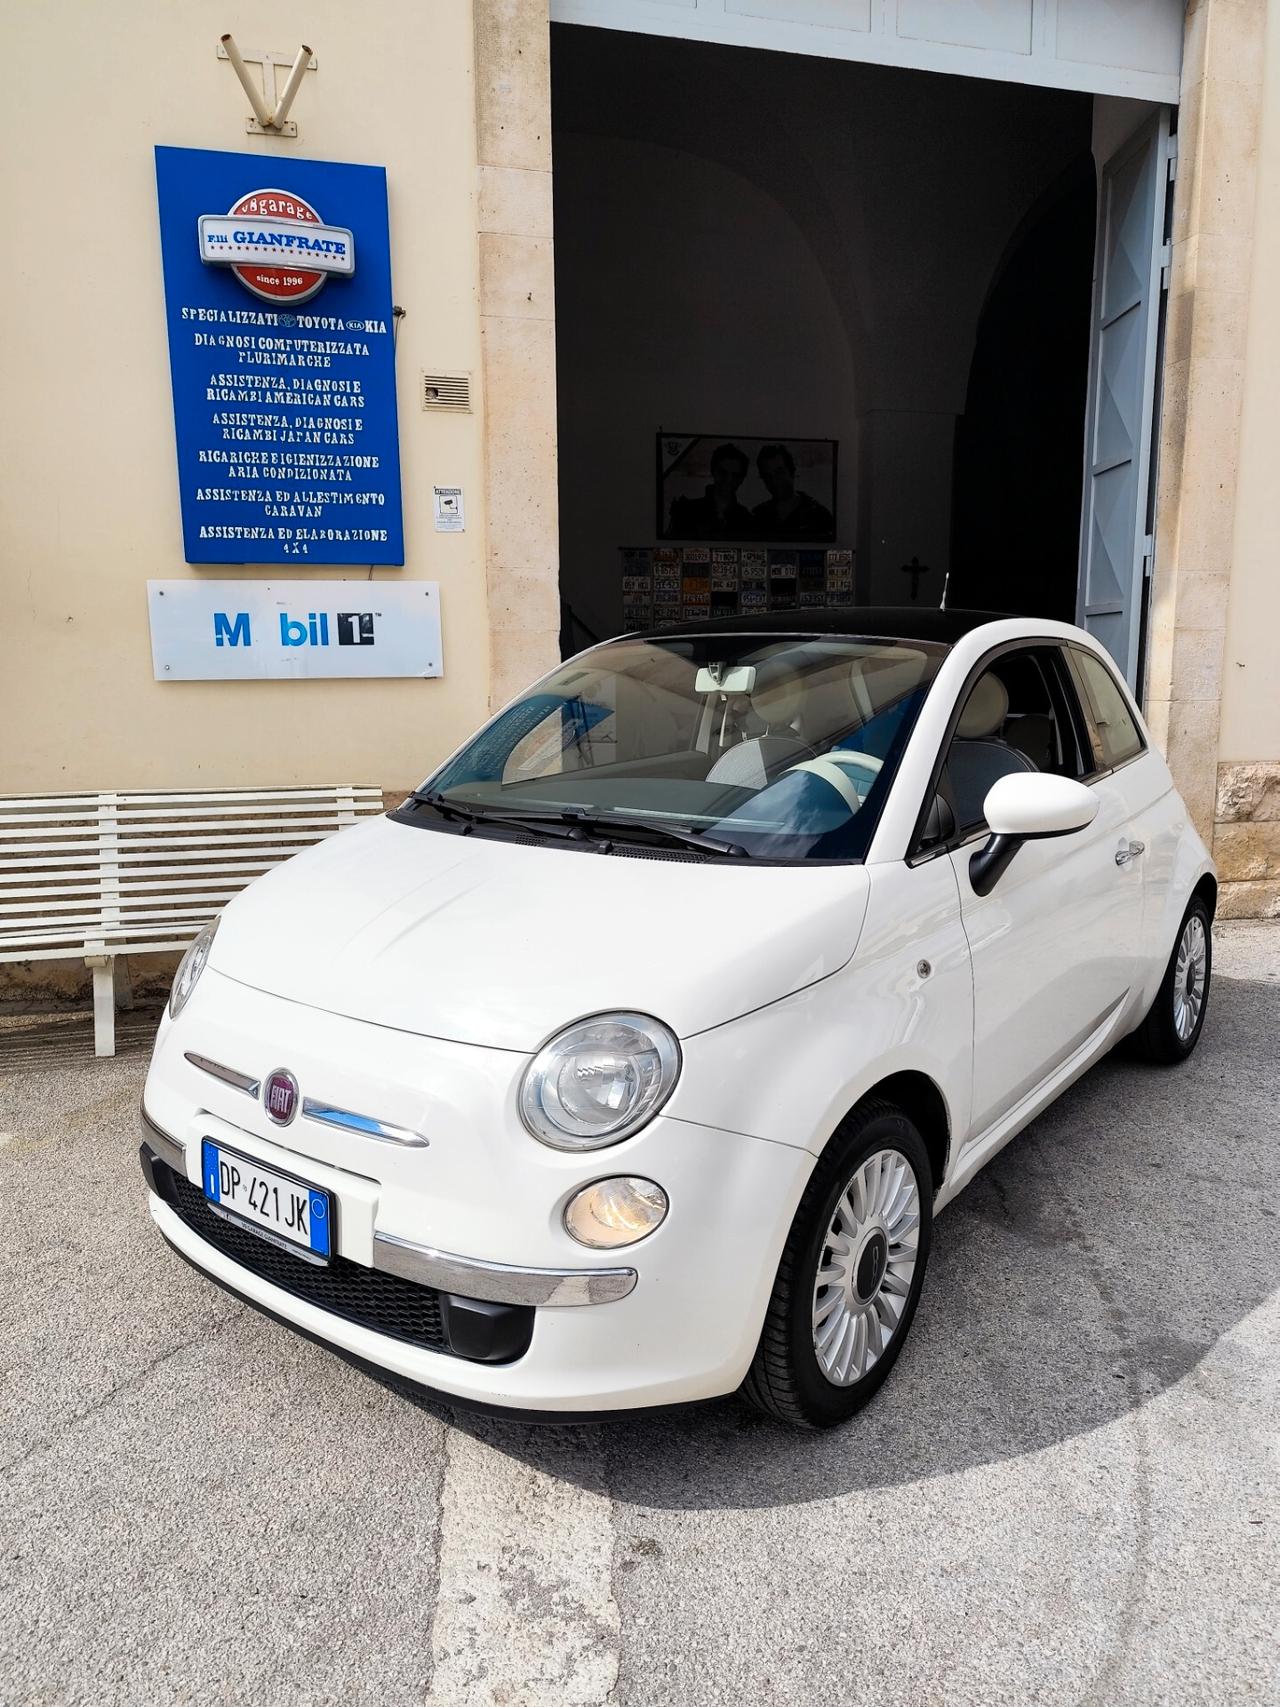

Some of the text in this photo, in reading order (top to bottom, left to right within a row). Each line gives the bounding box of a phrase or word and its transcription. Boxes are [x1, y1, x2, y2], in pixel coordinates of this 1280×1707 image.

[233, 231, 346, 255] GIANFRATE
[256, 275, 303, 286] since 1996
[181, 307, 278, 326] SPECIALIZZATI
[297, 315, 345, 331] TOYOTA
[364, 320, 387, 333] KIA
[194, 333, 370, 356] DIAGNOSI COMPUTERIZZATA
[238, 351, 331, 368] PLURIMARCHE
[293, 378, 351, 393] DIAGNOSI
[353, 381, 361, 393] E
[206, 388, 365, 408] RICAMBI AMERICAN CARS
[295, 416, 353, 431] DIAGNOSI
[355, 419, 363, 431] E
[222, 428, 355, 445] RICAMBI JAPAN CARS
[199, 450, 379, 468] RICARICHE E IGIENIZZAZIONE
[228, 466, 352, 481] ARIA CONDIZIONATA
[196, 488, 385, 506] ASSISTENZA ED ALLESTIMENTO
[264, 505, 322, 518] CARAVAN
[199, 526, 388, 542] ASSISTENZA ED ELABORAZIONE
[270, 1084, 292, 1113] FIAT
